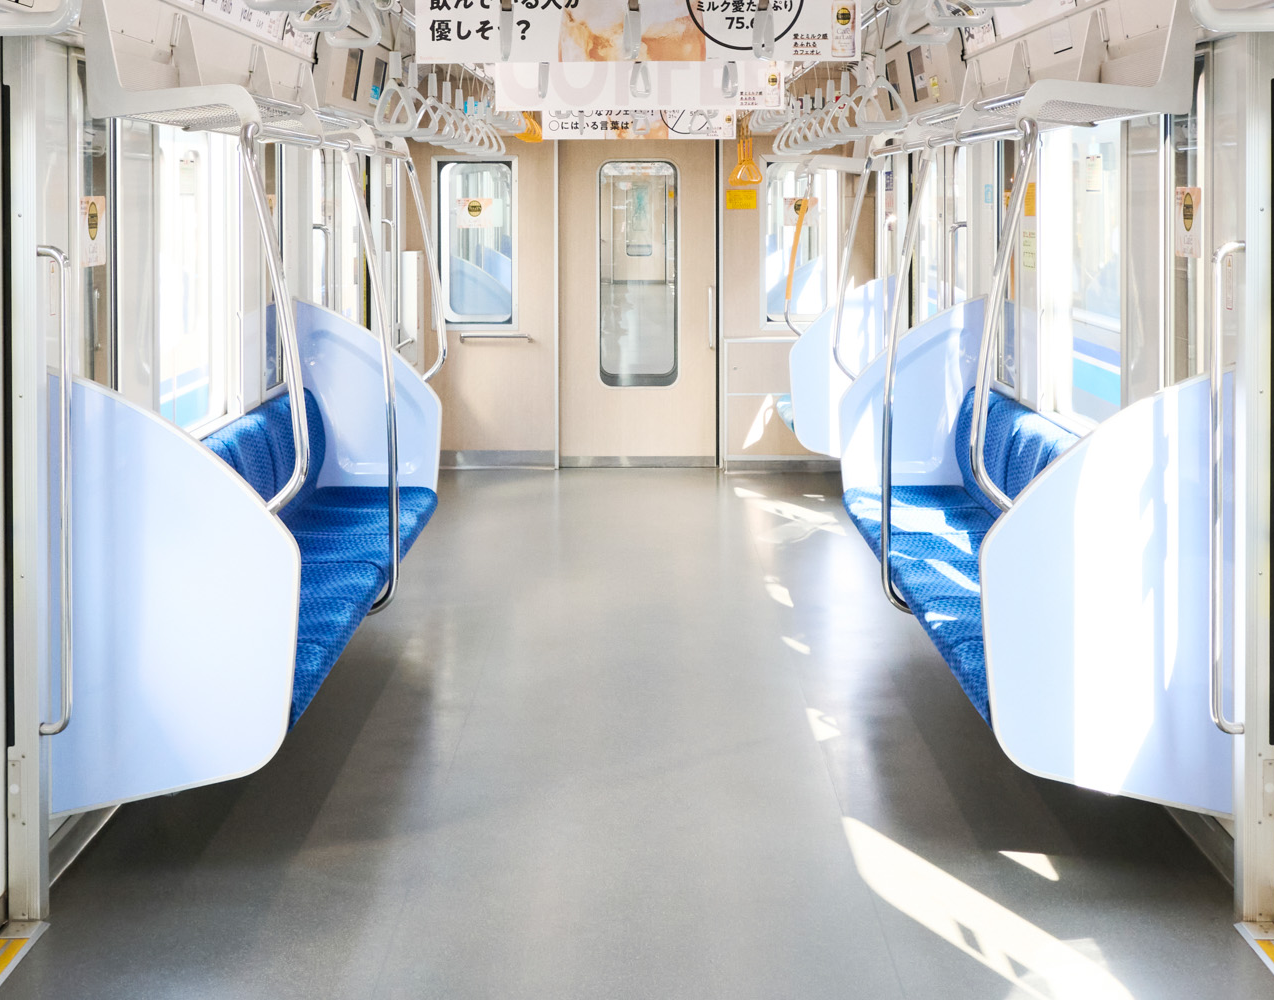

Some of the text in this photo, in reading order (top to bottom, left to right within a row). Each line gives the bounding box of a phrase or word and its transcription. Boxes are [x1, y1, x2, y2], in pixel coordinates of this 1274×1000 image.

[696, 0, 794, 12] ミルク愛たぷり
[430, 19, 531, 41] 優しそ?
